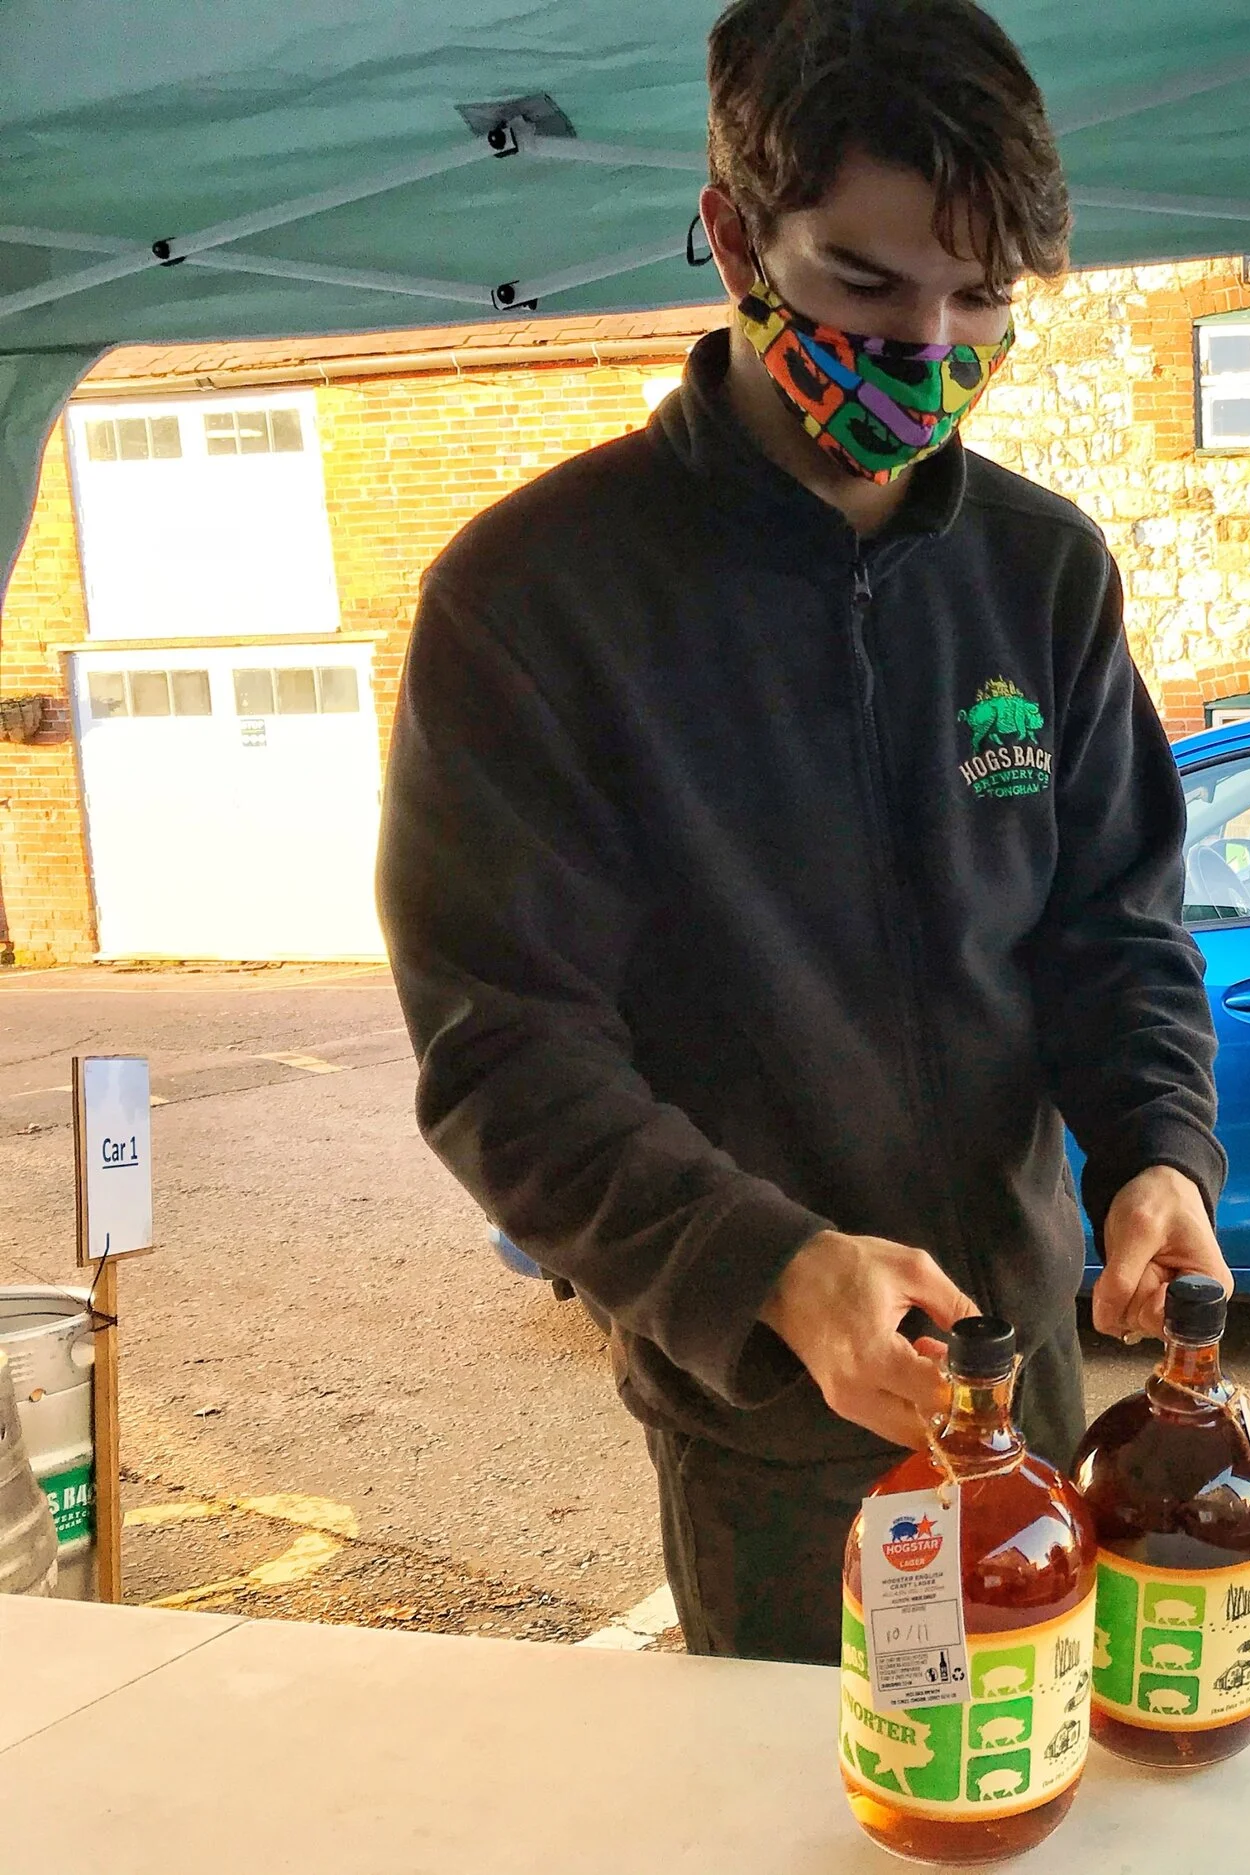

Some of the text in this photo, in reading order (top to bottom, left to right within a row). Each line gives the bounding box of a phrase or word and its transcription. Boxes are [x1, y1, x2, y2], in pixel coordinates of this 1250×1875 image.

[958, 745, 1053, 786] HOGS BACK
[972, 769, 1034, 793] BREWERY
[102, 1135, 138, 1163] Car 1
[886, 1539, 939, 1556] HOGSTAR
[899, 1558, 925, 1568] LAGER
[843, 1684, 917, 1746] NORTER
